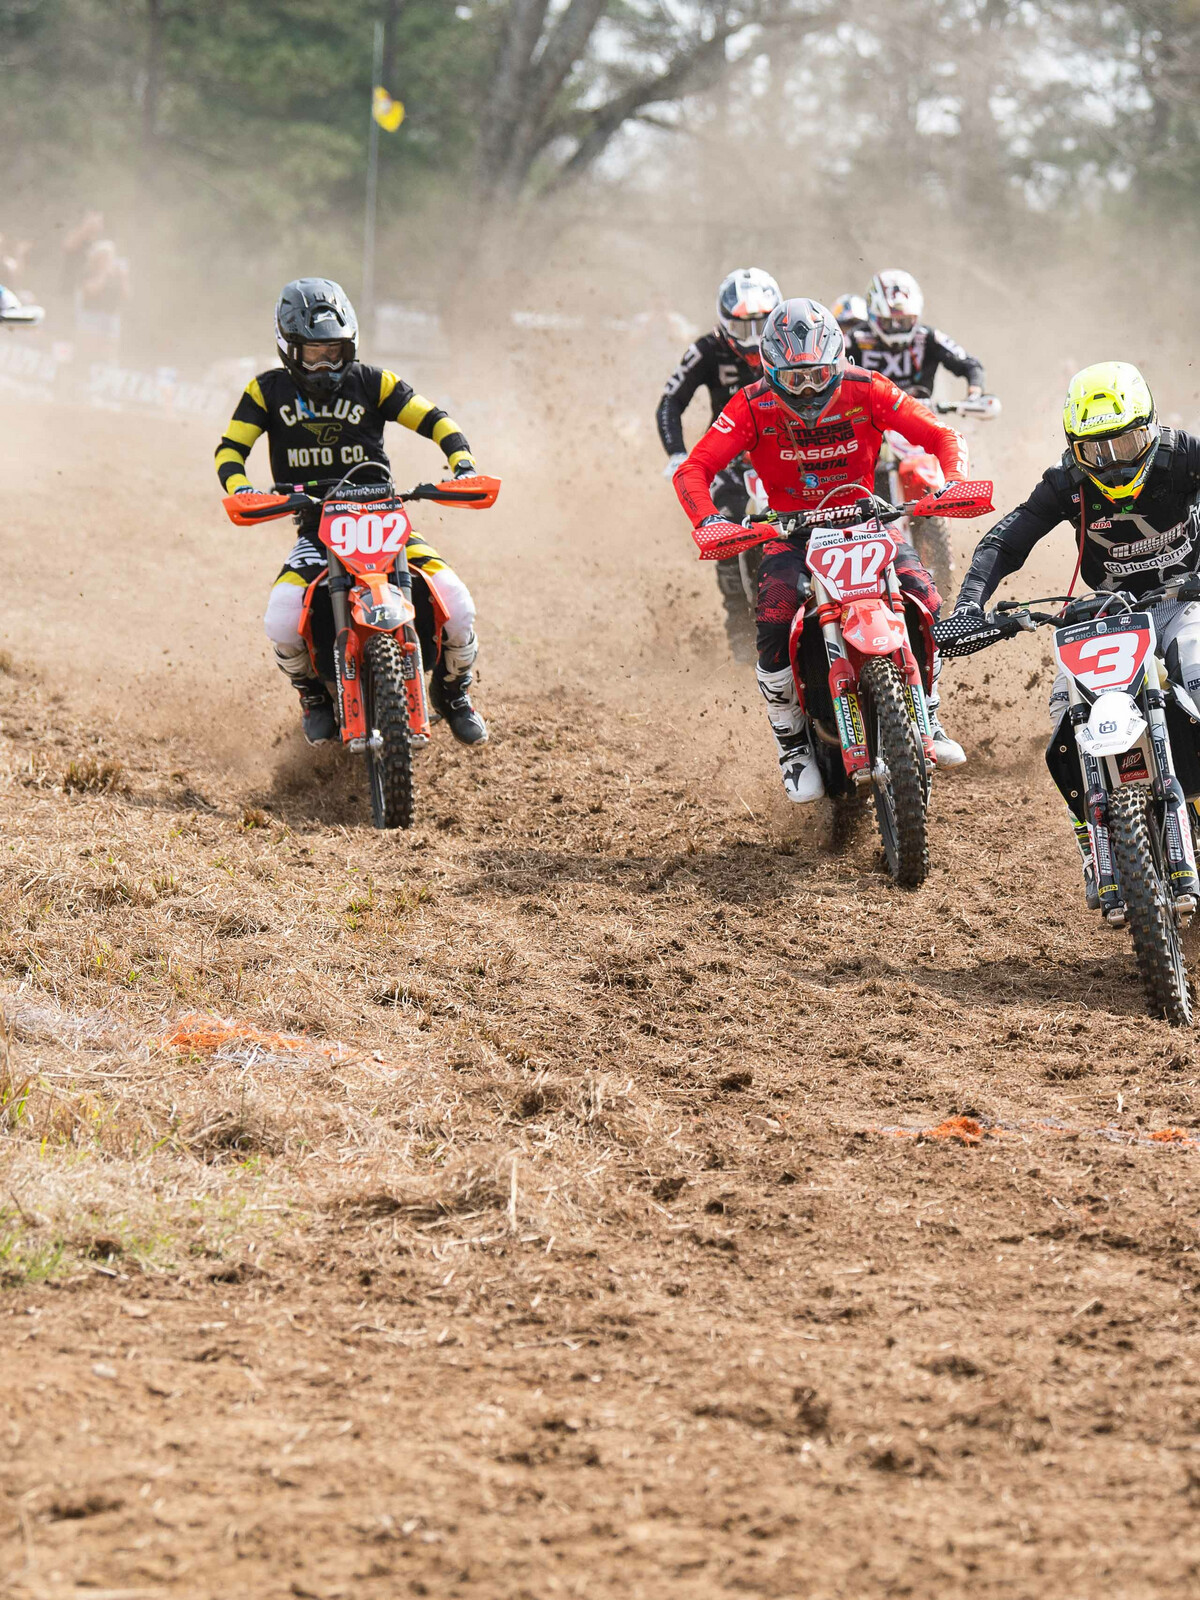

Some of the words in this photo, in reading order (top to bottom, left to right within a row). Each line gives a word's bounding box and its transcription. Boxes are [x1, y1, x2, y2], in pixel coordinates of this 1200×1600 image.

[279, 397, 366, 426] CALLUS
[288, 448, 333, 468] MOTO
[340, 445, 369, 465] CO.
[780, 440, 859, 461] GASGAS
[335, 502, 403, 511] GNCCRACING.CM
[330, 513, 407, 556] 902
[821, 541, 886, 589] 212
[1124, 542, 1190, 573] Husqvarna
[1075, 625, 1142, 641] GNCCCING.COM
[1075, 632, 1140, 691] 3
[839, 695, 856, 745] DUNLOP
